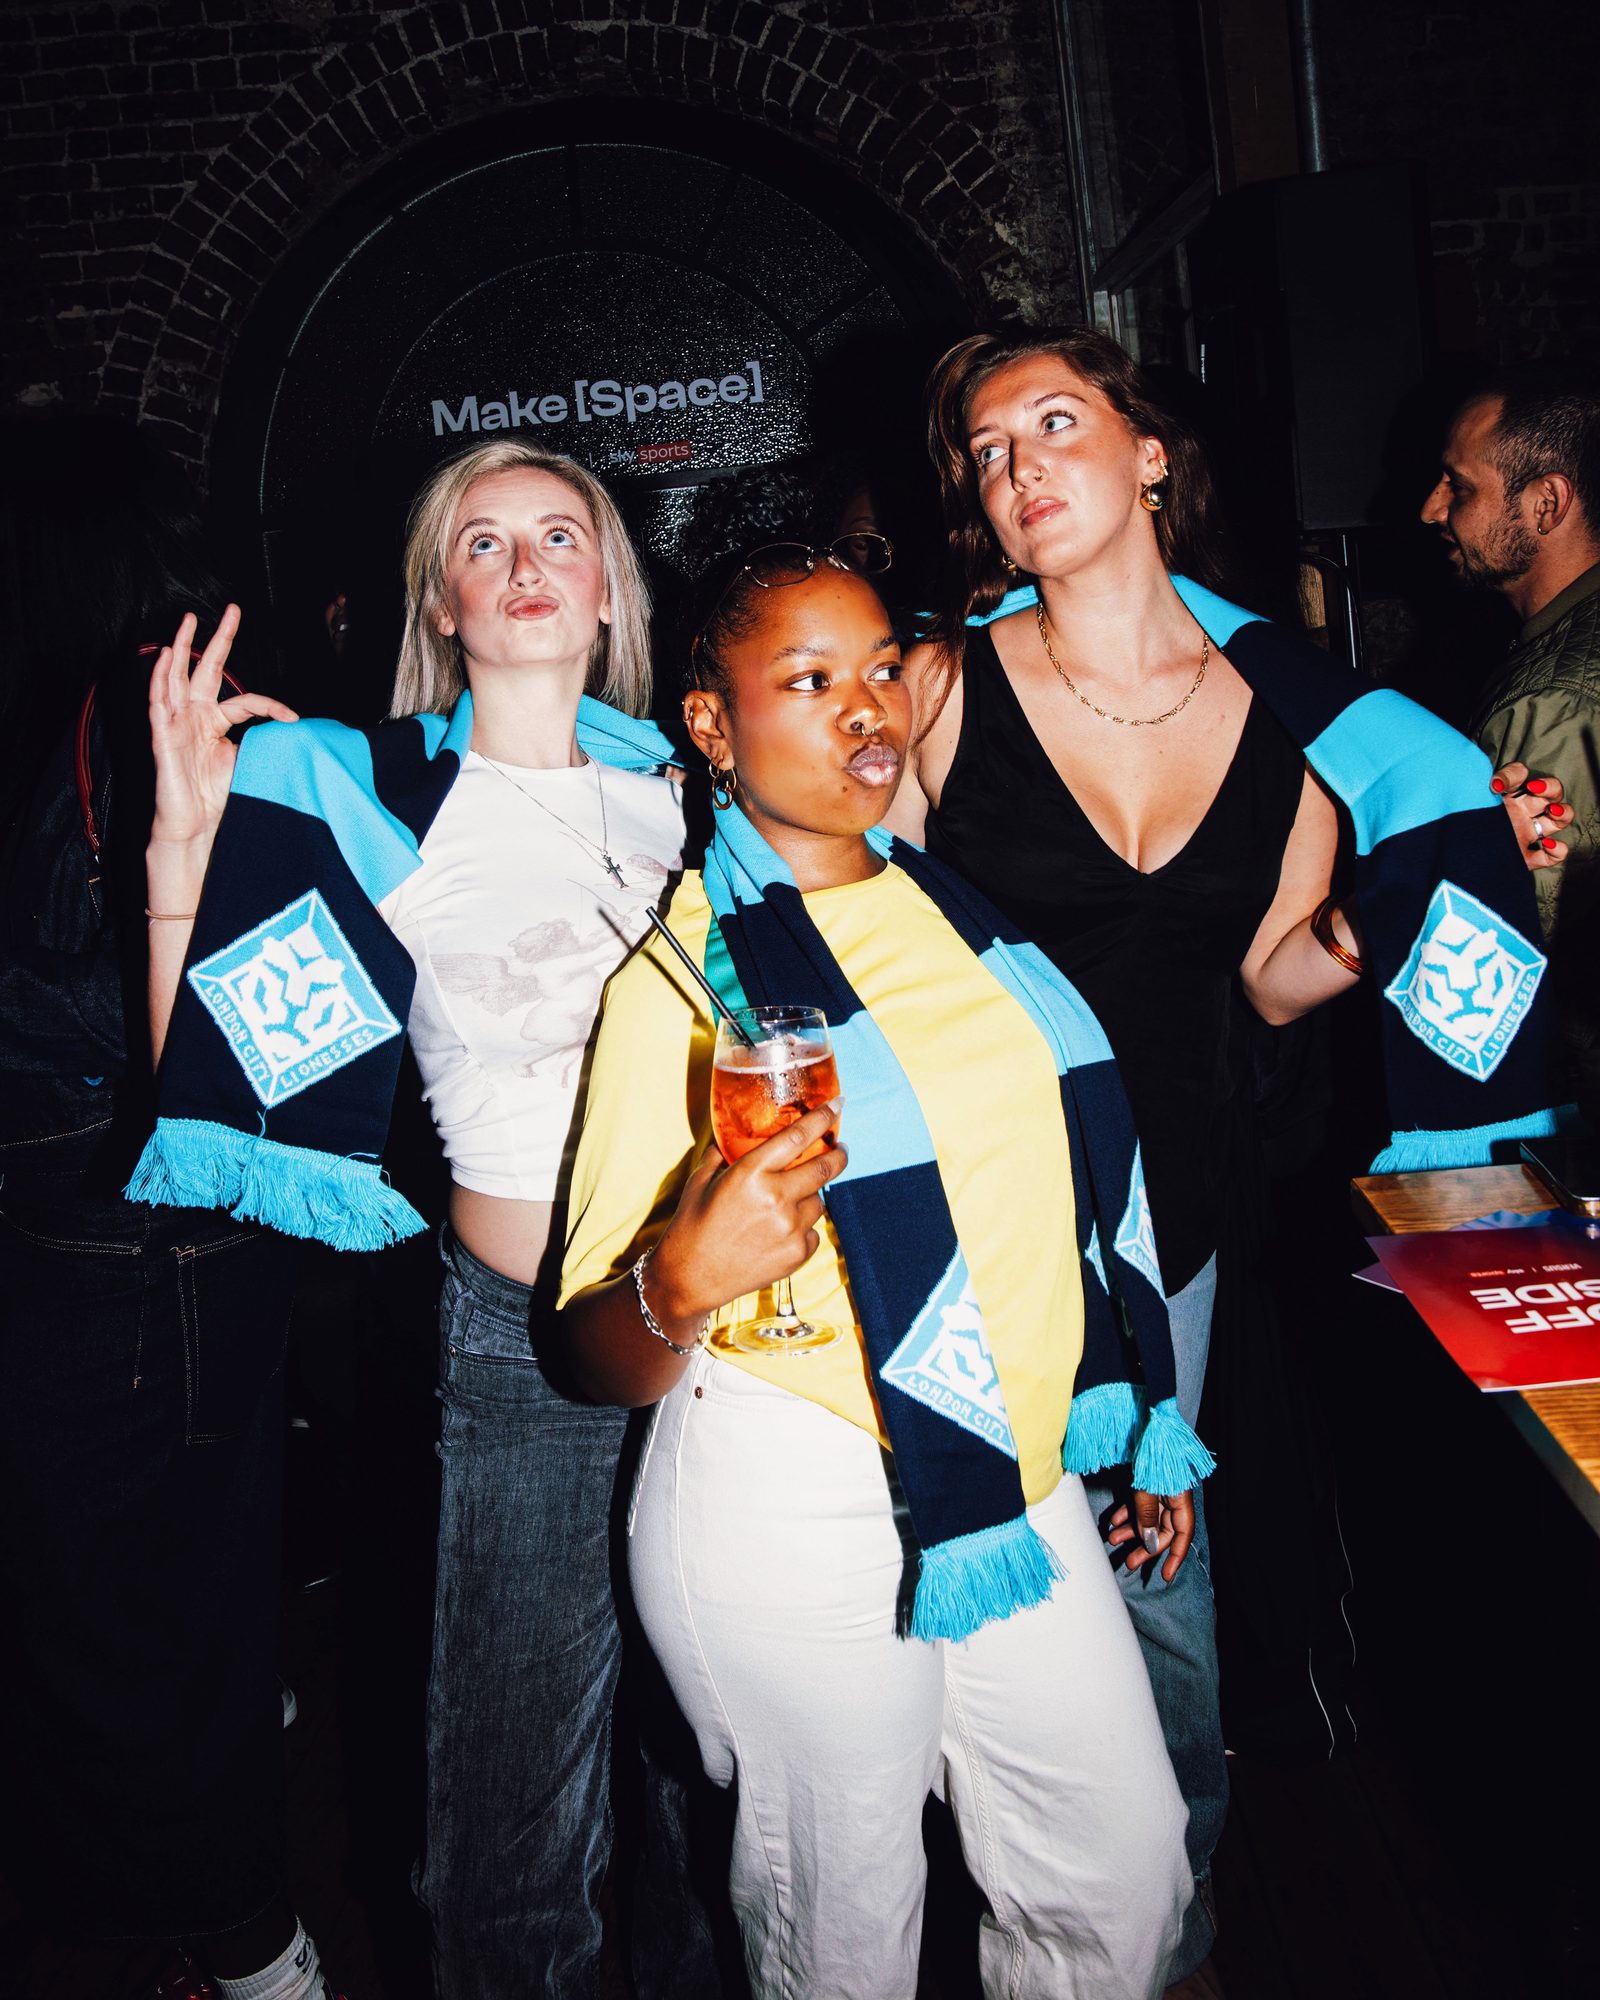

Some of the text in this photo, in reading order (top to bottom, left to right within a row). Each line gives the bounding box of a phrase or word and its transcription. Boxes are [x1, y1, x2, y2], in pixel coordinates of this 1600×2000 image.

[432, 360, 765, 436] Make [Space]
[610, 444, 689, 464] sky sports
[204, 984, 271, 1083] LONDON CITY
[1482, 973, 1537, 1059] LIONESSES
[281, 1030, 374, 1088] LIONESSES
[1437, 1037, 1472, 1065] CITY
[906, 1374, 971, 1418] LONDON
